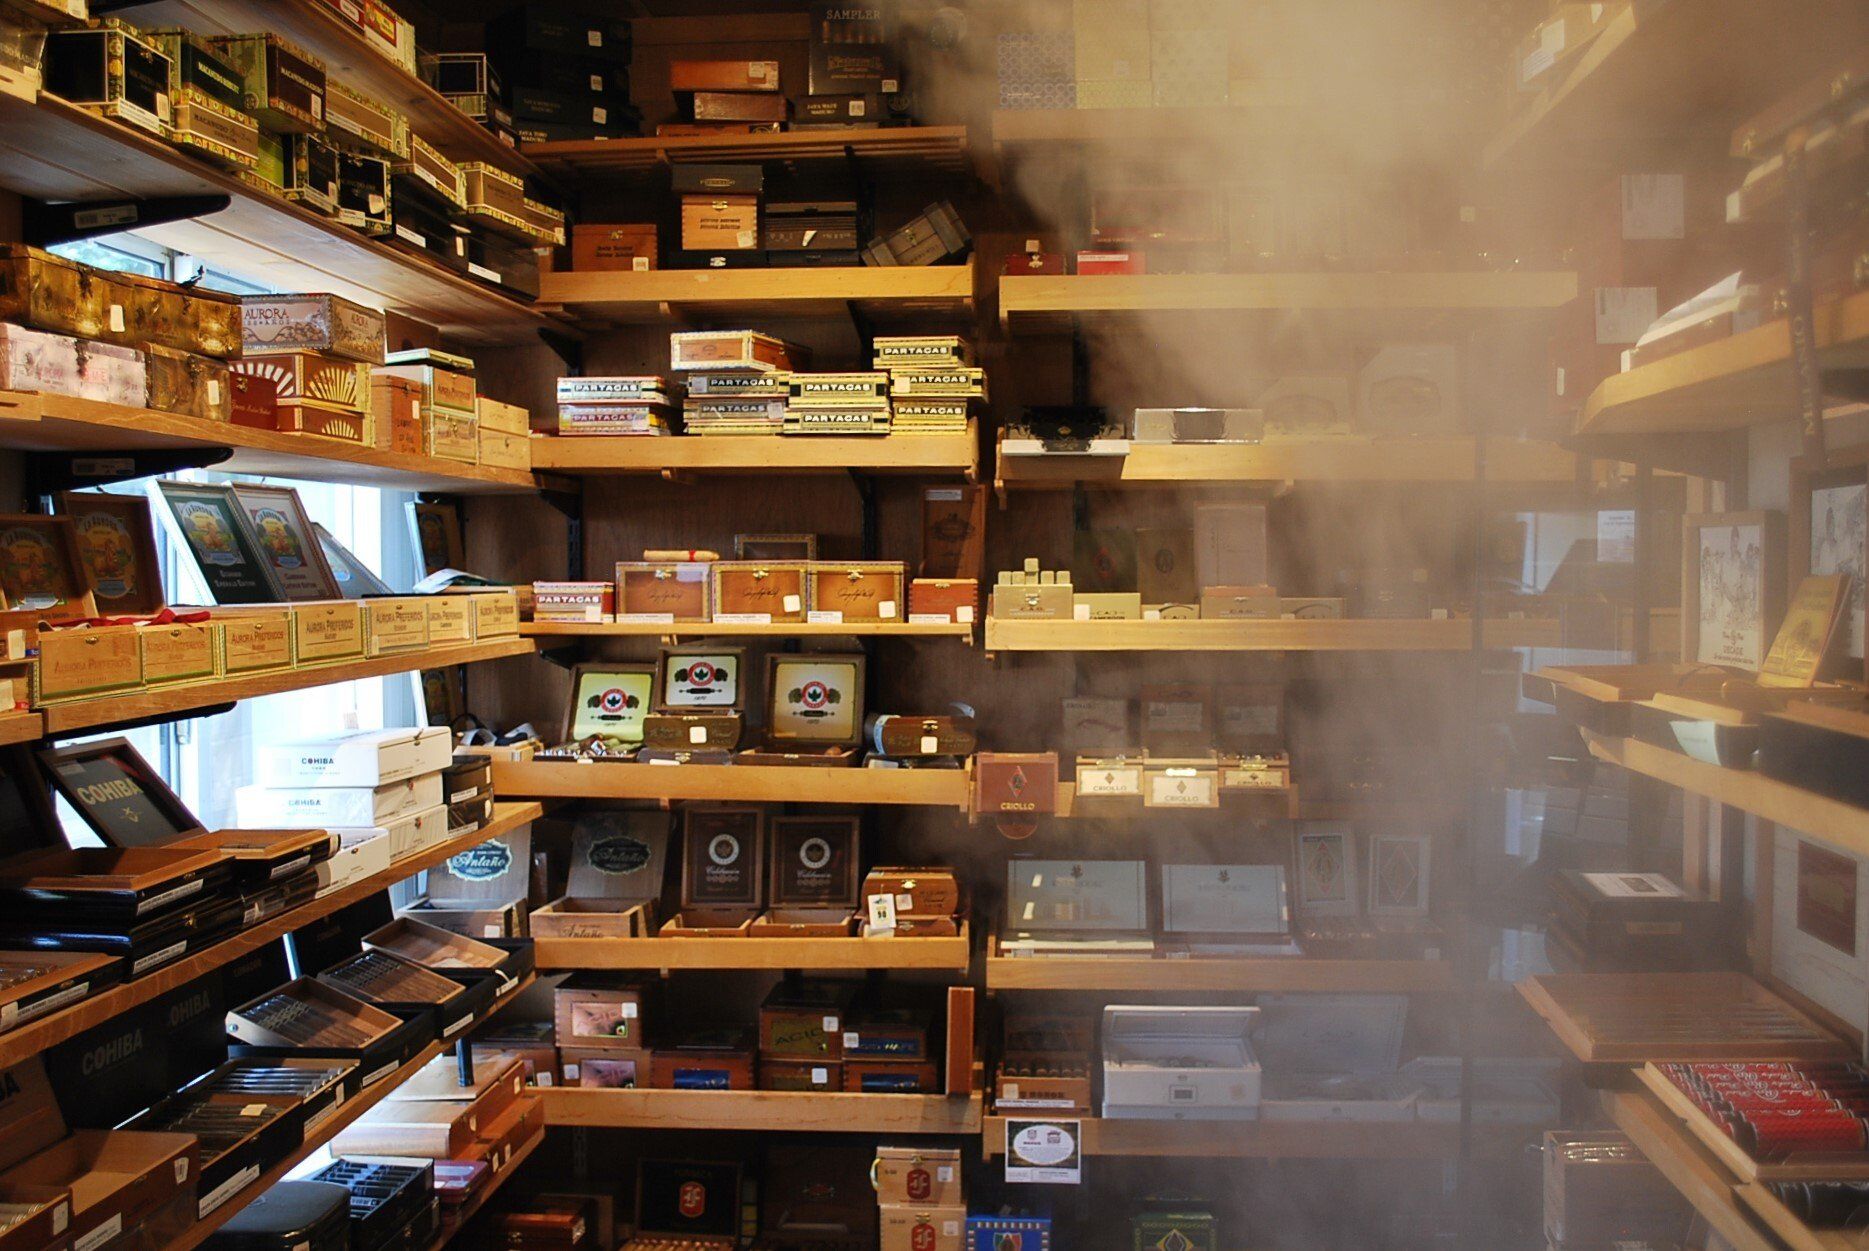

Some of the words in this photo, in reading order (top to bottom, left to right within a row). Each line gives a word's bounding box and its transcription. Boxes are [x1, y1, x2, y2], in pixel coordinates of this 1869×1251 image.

[826, 9, 880, 20] SAMPLER
[244, 308, 290, 320] AURORA
[884, 347, 948, 355] PARTAGAS
[574, 384, 639, 392] PARTAGAS
[231, 633, 254, 644] AURORA
[301, 757, 335, 765] COHIBA
[77, 777, 144, 806] COHIBA
[1000, 803, 1036, 811] CRIOLLO
[452, 851, 505, 868] Antaño
[169, 990, 211, 1028] OHIBA
[82, 1028, 143, 1076] COHIBA
